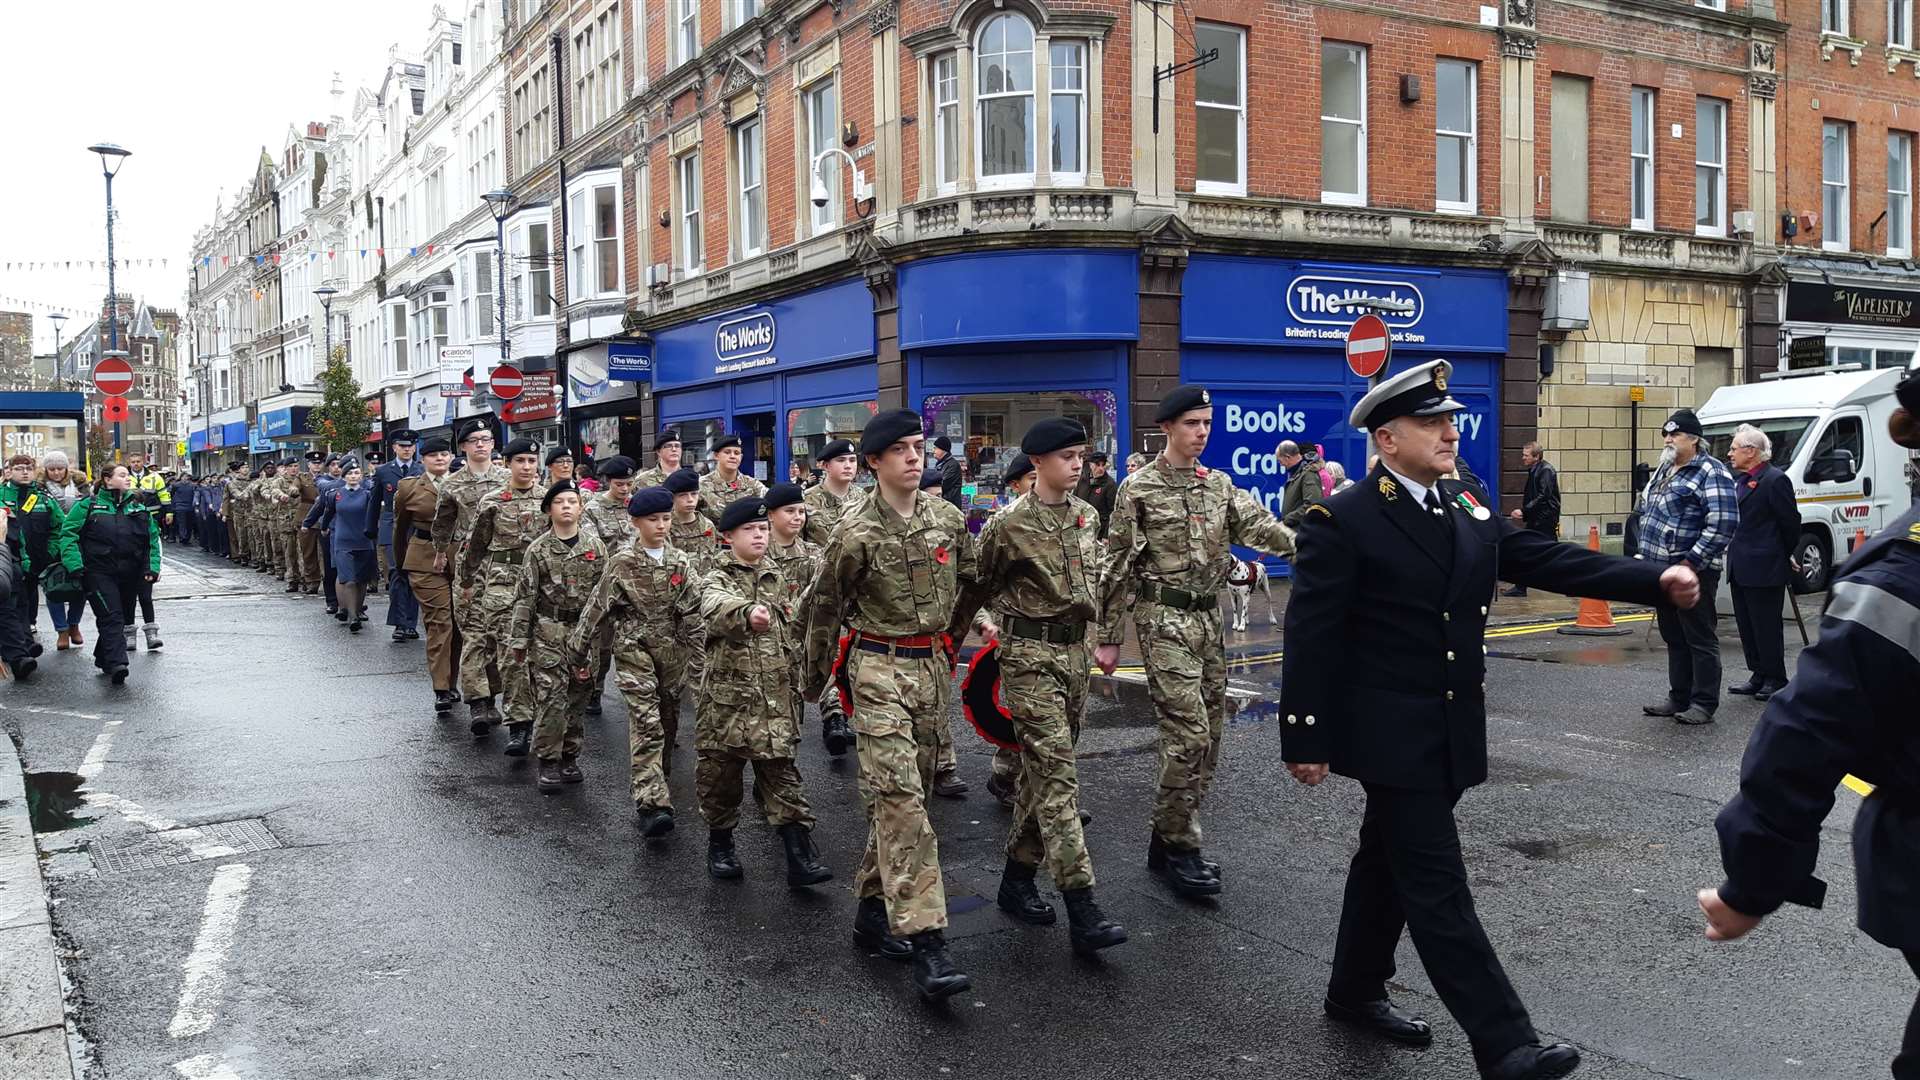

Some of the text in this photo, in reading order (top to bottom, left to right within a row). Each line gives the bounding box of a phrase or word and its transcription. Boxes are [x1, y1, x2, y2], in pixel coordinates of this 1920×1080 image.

[1297, 285, 1341, 314] The
[1846, 292, 1912, 318] VAPEISTRY
[719, 322, 771, 352] The Works
[1285, 328, 1350, 341] Britain's Leading
[1390, 332, 1425, 343] ook Store
[612, 357, 648, 366] The Works
[1226, 403, 1306, 433] Books
[5, 432, 44, 448] STOP
